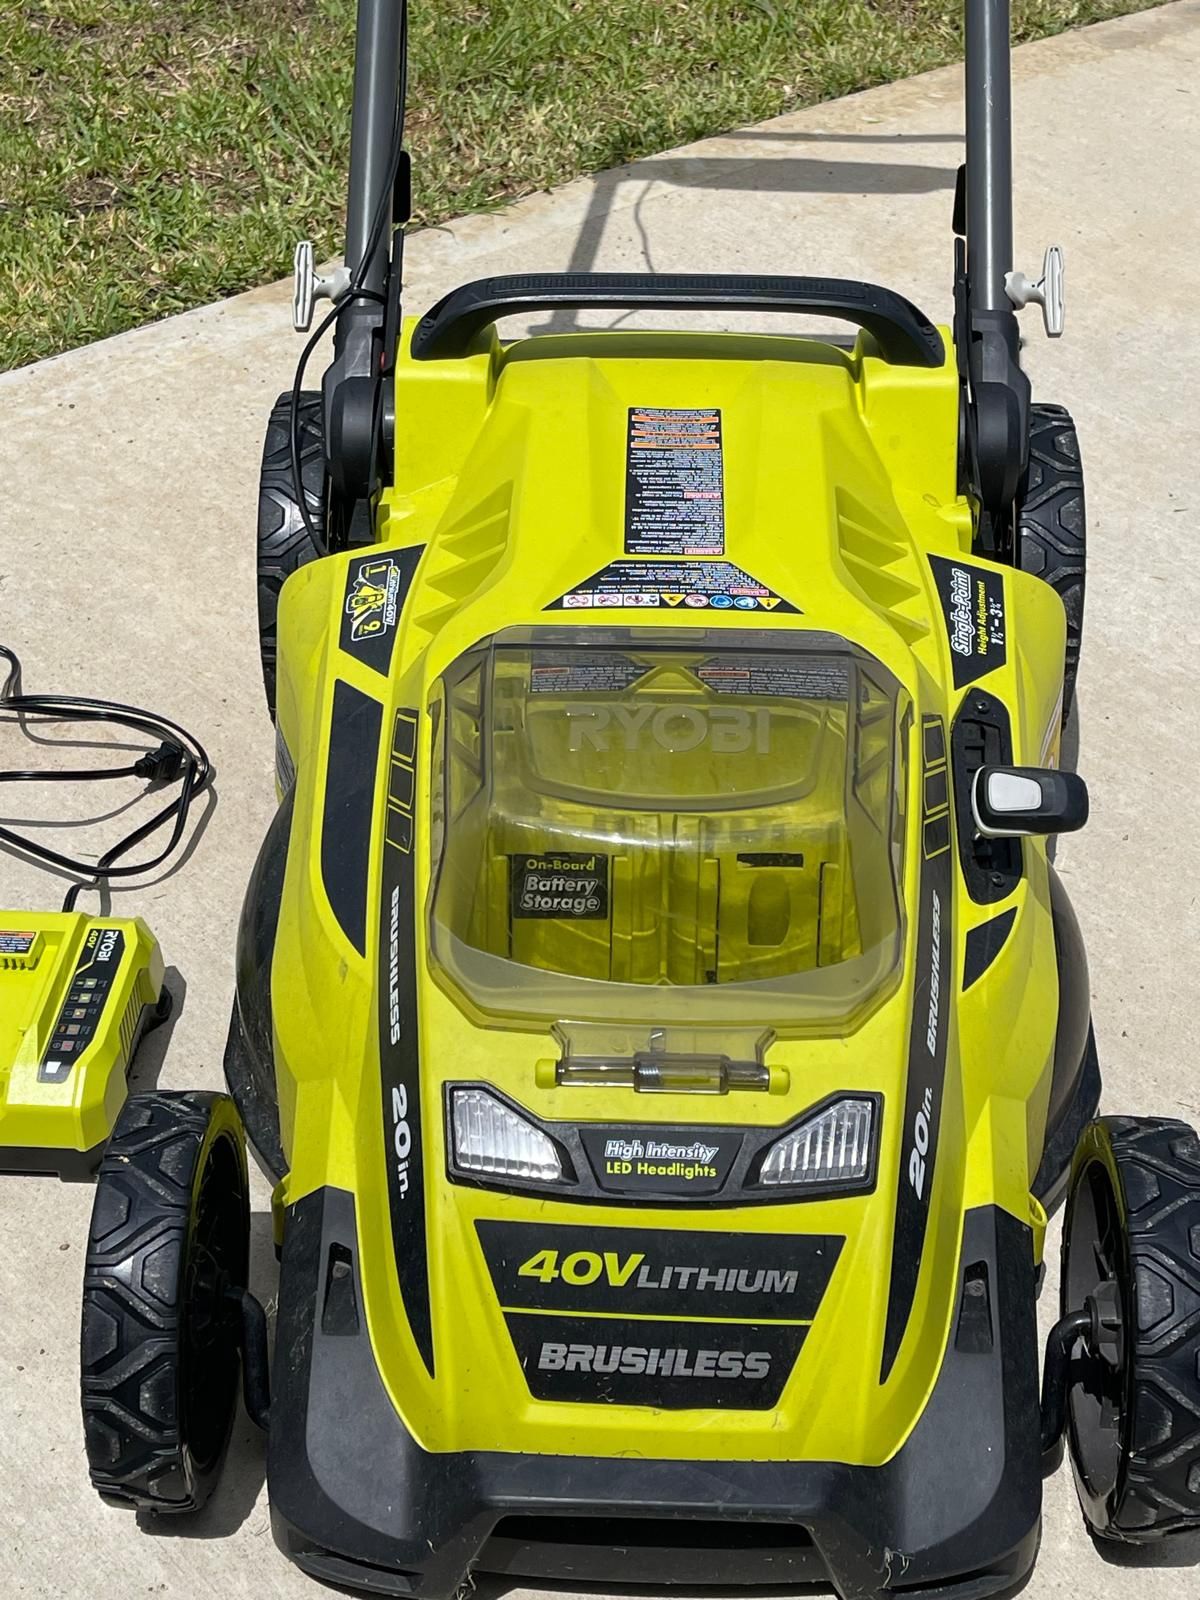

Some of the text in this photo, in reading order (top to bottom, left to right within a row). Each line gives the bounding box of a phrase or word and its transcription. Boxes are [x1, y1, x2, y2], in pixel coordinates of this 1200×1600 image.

[951, 569, 974, 655] Single-Point
[977, 581, 988, 655] Height Adjustment
[566, 703, 770, 754] RYOBI
[526, 856, 595, 871] On-Board
[525, 876, 597, 896] Battery
[521, 893, 599, 913] Storage
[87, 930, 98, 948] 40V
[97, 931, 118, 961] RYOBI
[388, 885, 402, 1046] BRUSHLESS
[926, 889, 942, 1057] BRUSHLESS
[604, 1139, 720, 1163] High Intensity
[606, 1161, 717, 1180] LED Headlights
[537, 1341, 773, 1379] BRUSHLESS
